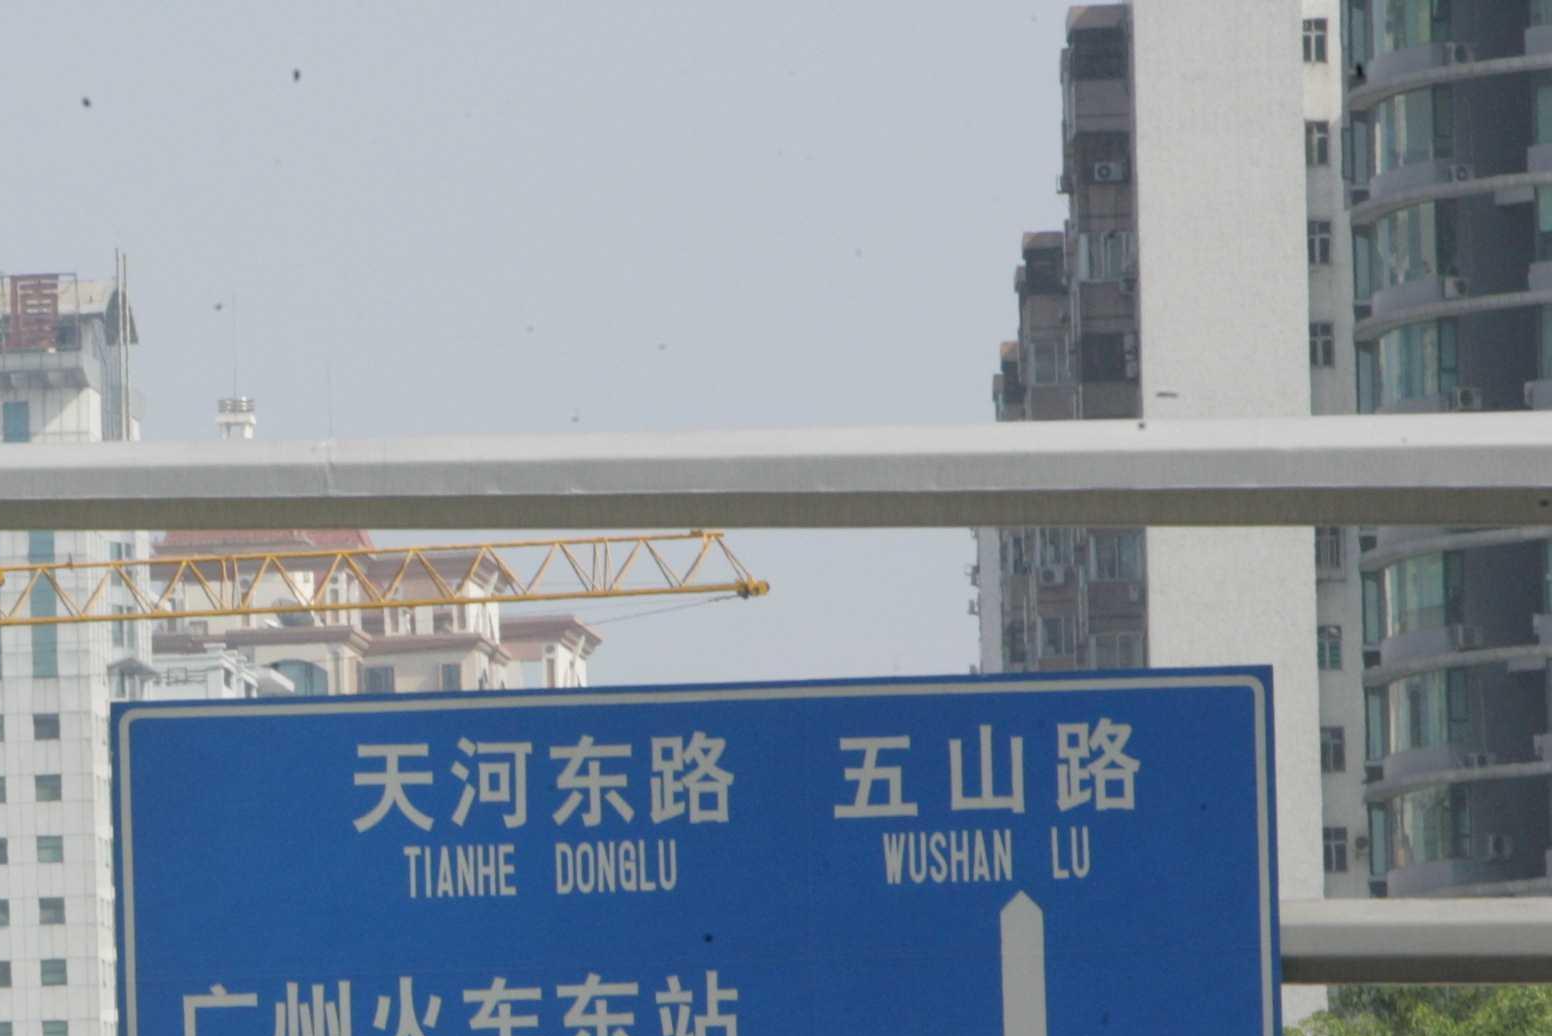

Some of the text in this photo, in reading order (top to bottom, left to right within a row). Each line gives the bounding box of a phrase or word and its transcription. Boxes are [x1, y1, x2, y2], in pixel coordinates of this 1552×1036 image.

[353, 731, 734, 833] 天河东路
[834, 718, 1140, 818] 五山路
[403, 839, 678, 898] TIANHE DONGLU
[884, 827, 1091, 884] WUSHAN LU
